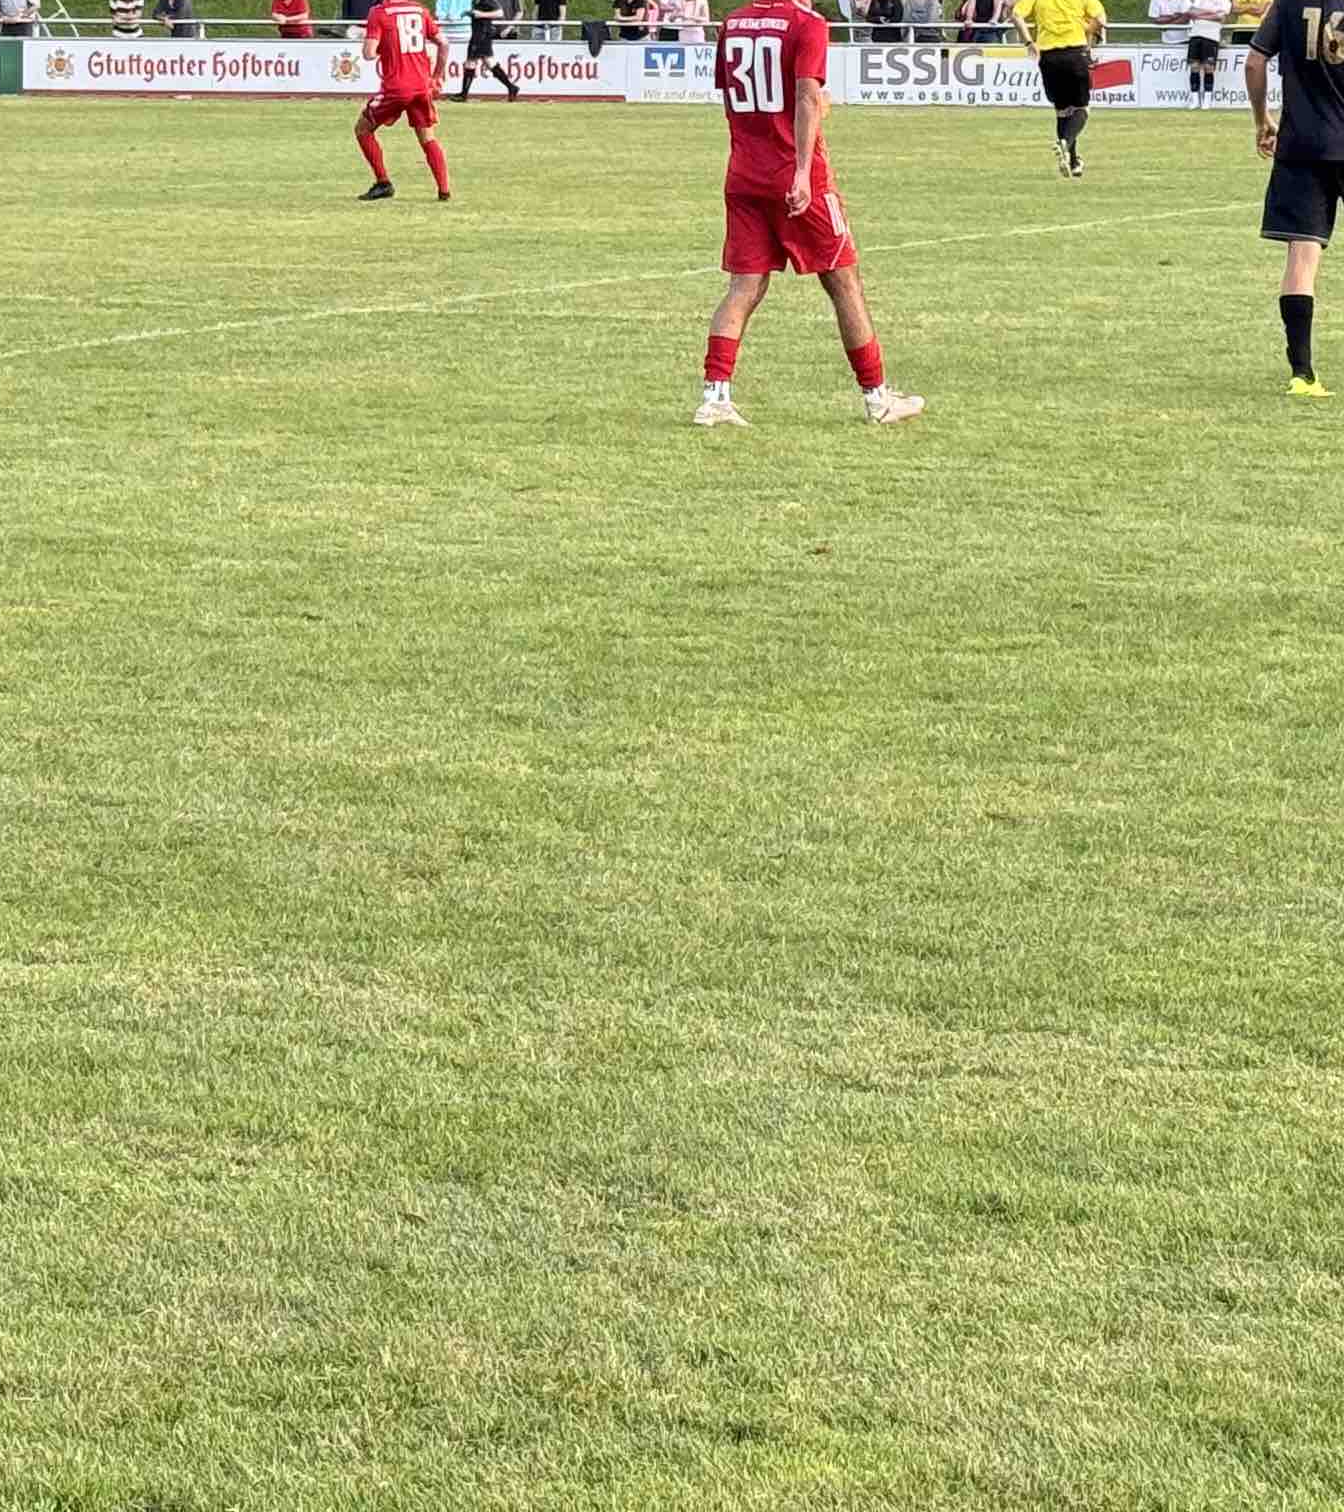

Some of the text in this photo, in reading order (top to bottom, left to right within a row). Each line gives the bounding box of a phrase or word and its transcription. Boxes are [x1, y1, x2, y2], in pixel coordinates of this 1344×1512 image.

[396, 13, 424, 54] 18
[87, 50, 302, 82] Stuttgarter Hofbräu
[506, 53, 600, 84] Hofbräu
[725, 36, 784, 113] 30
[859, 47, 1040, 87] ESSIG bau
[859, 89, 1041, 105] www.essigbau.d
